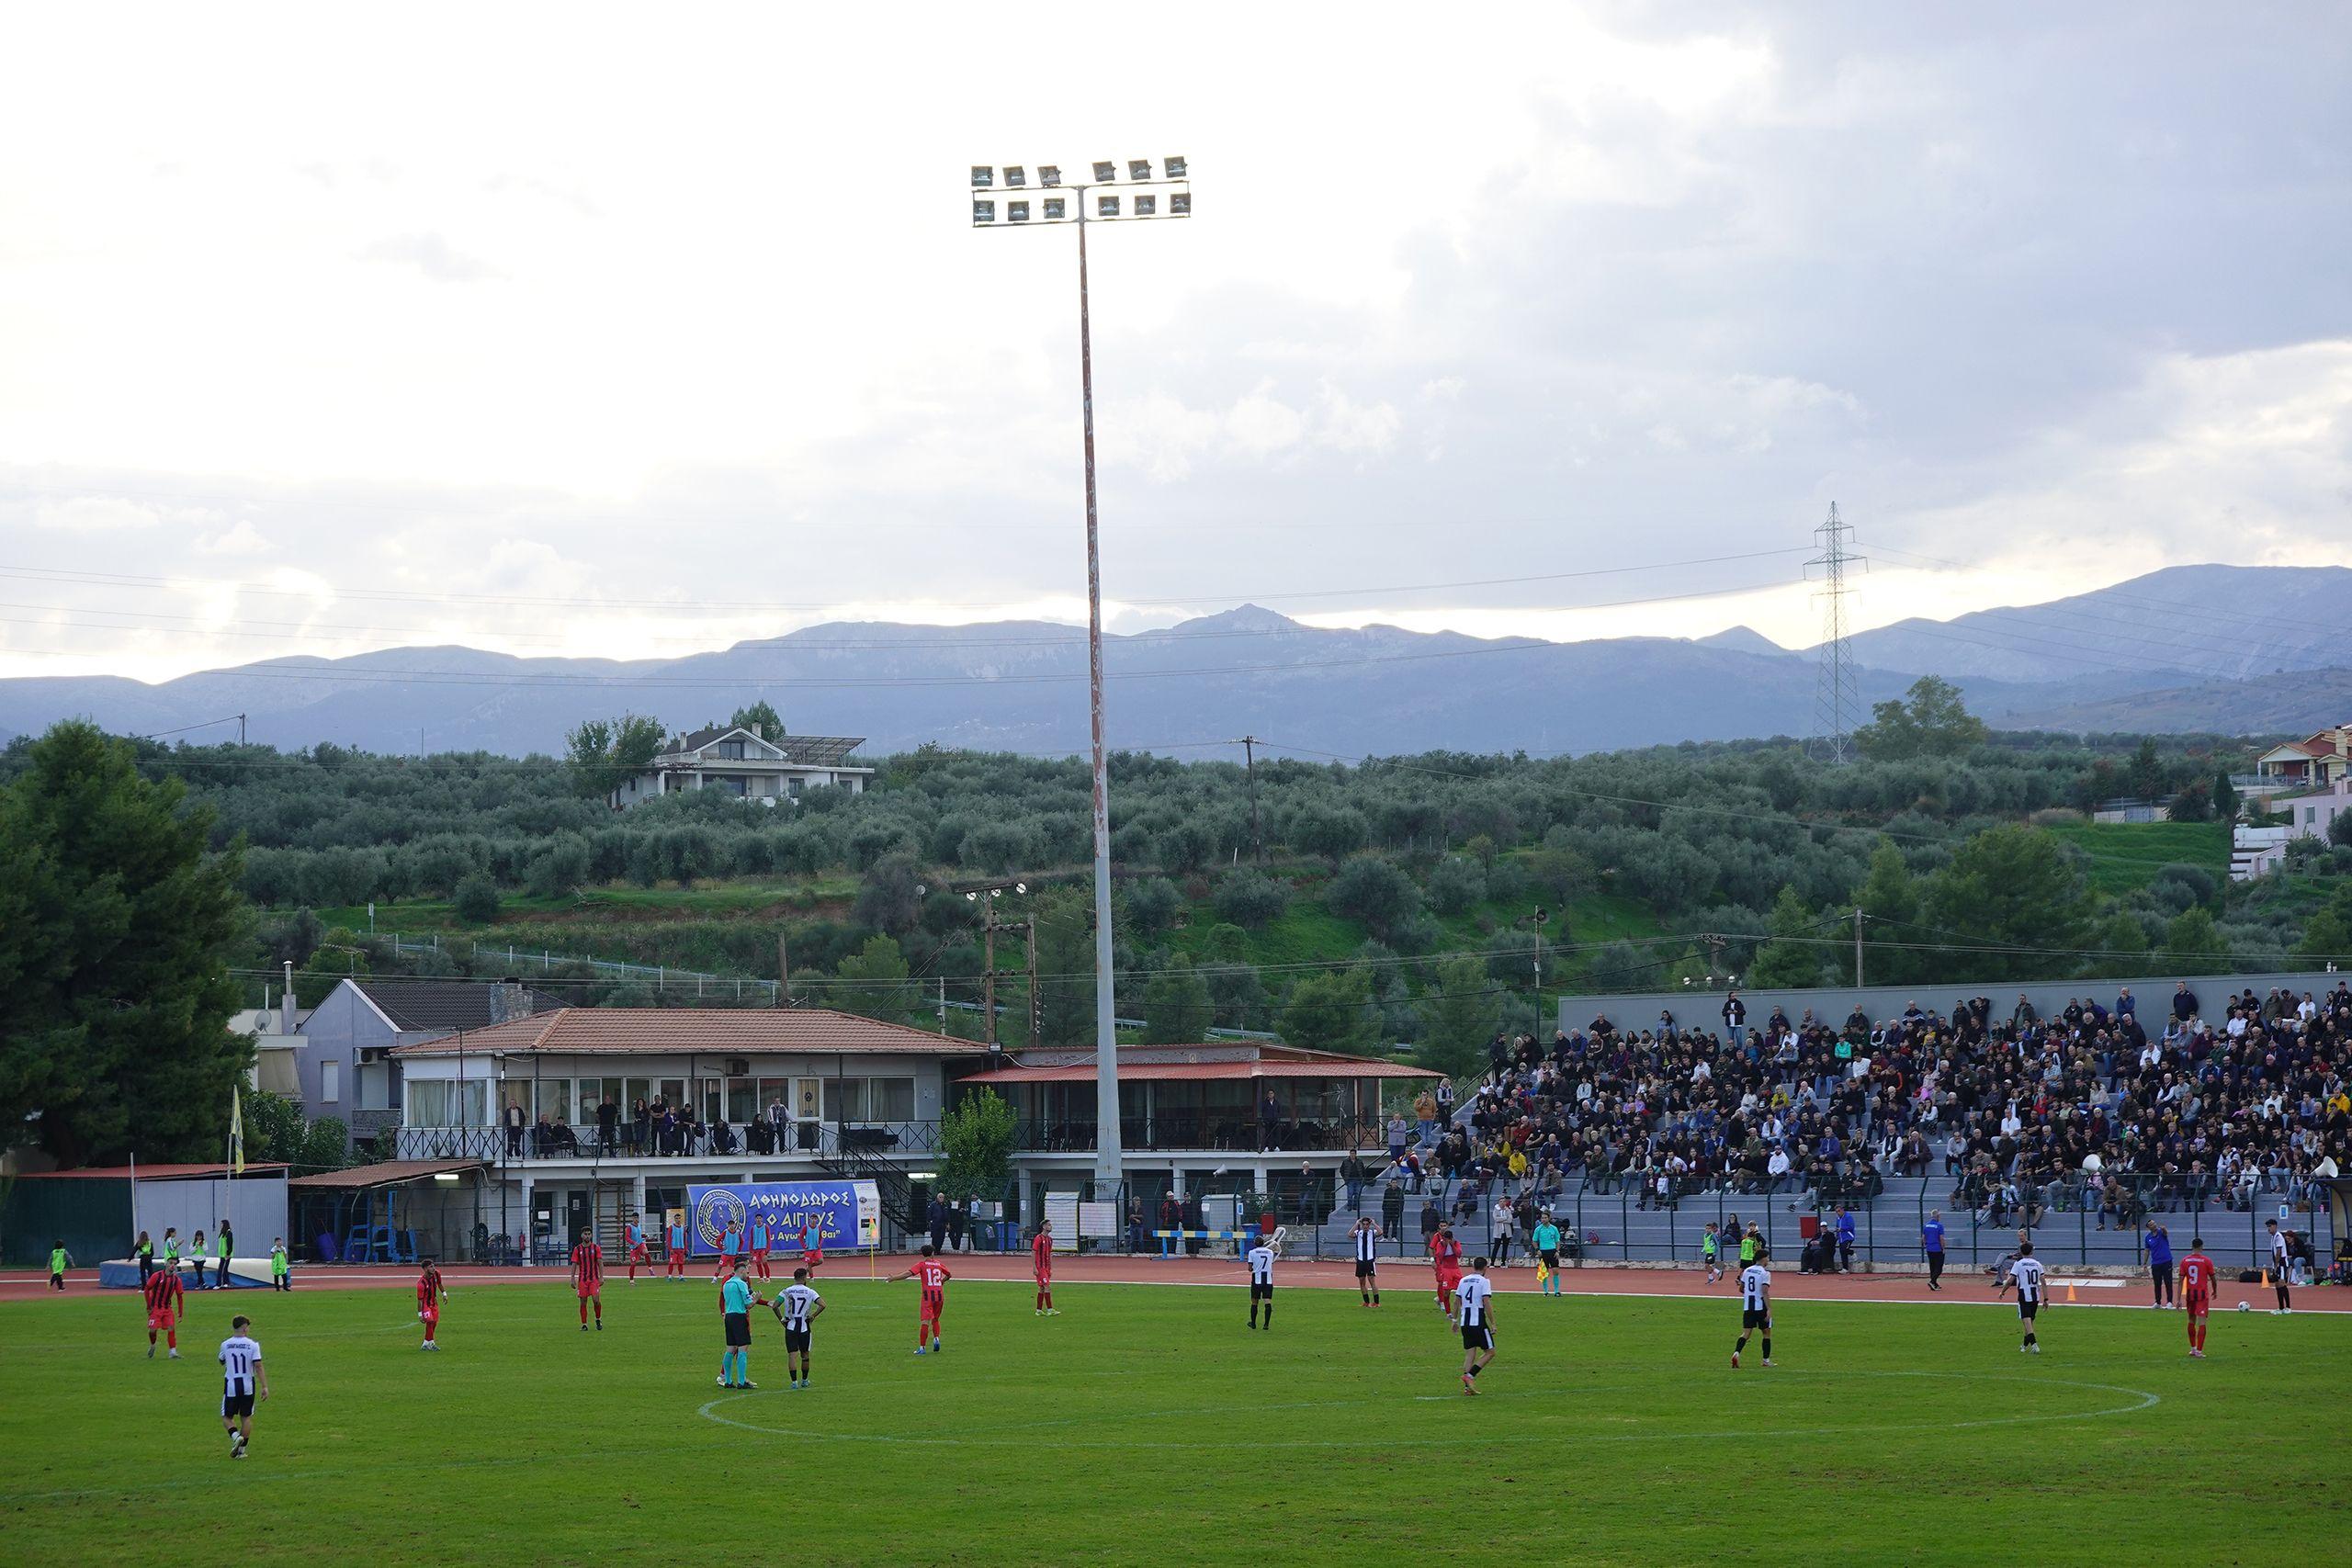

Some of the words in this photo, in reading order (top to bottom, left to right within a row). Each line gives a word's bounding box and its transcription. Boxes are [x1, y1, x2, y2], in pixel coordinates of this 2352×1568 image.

[749, 1191, 850, 1209] ΑΘΗΝΟΔΩΡΟΣ
[780, 1211, 835, 1228] ΑΙΓΙΥΣ
[1261, 1256, 1268, 1269] 7
[926, 1268, 942, 1286] 12
[1747, 1276, 1756, 1292] 8
[2026, 1269, 2039, 1285] 10
[2188, 1265, 2199, 1285] 9
[790, 1294, 807, 1314] 17
[1465, 1286, 1474, 1304] 4
[232, 1353, 246, 1373] 11
